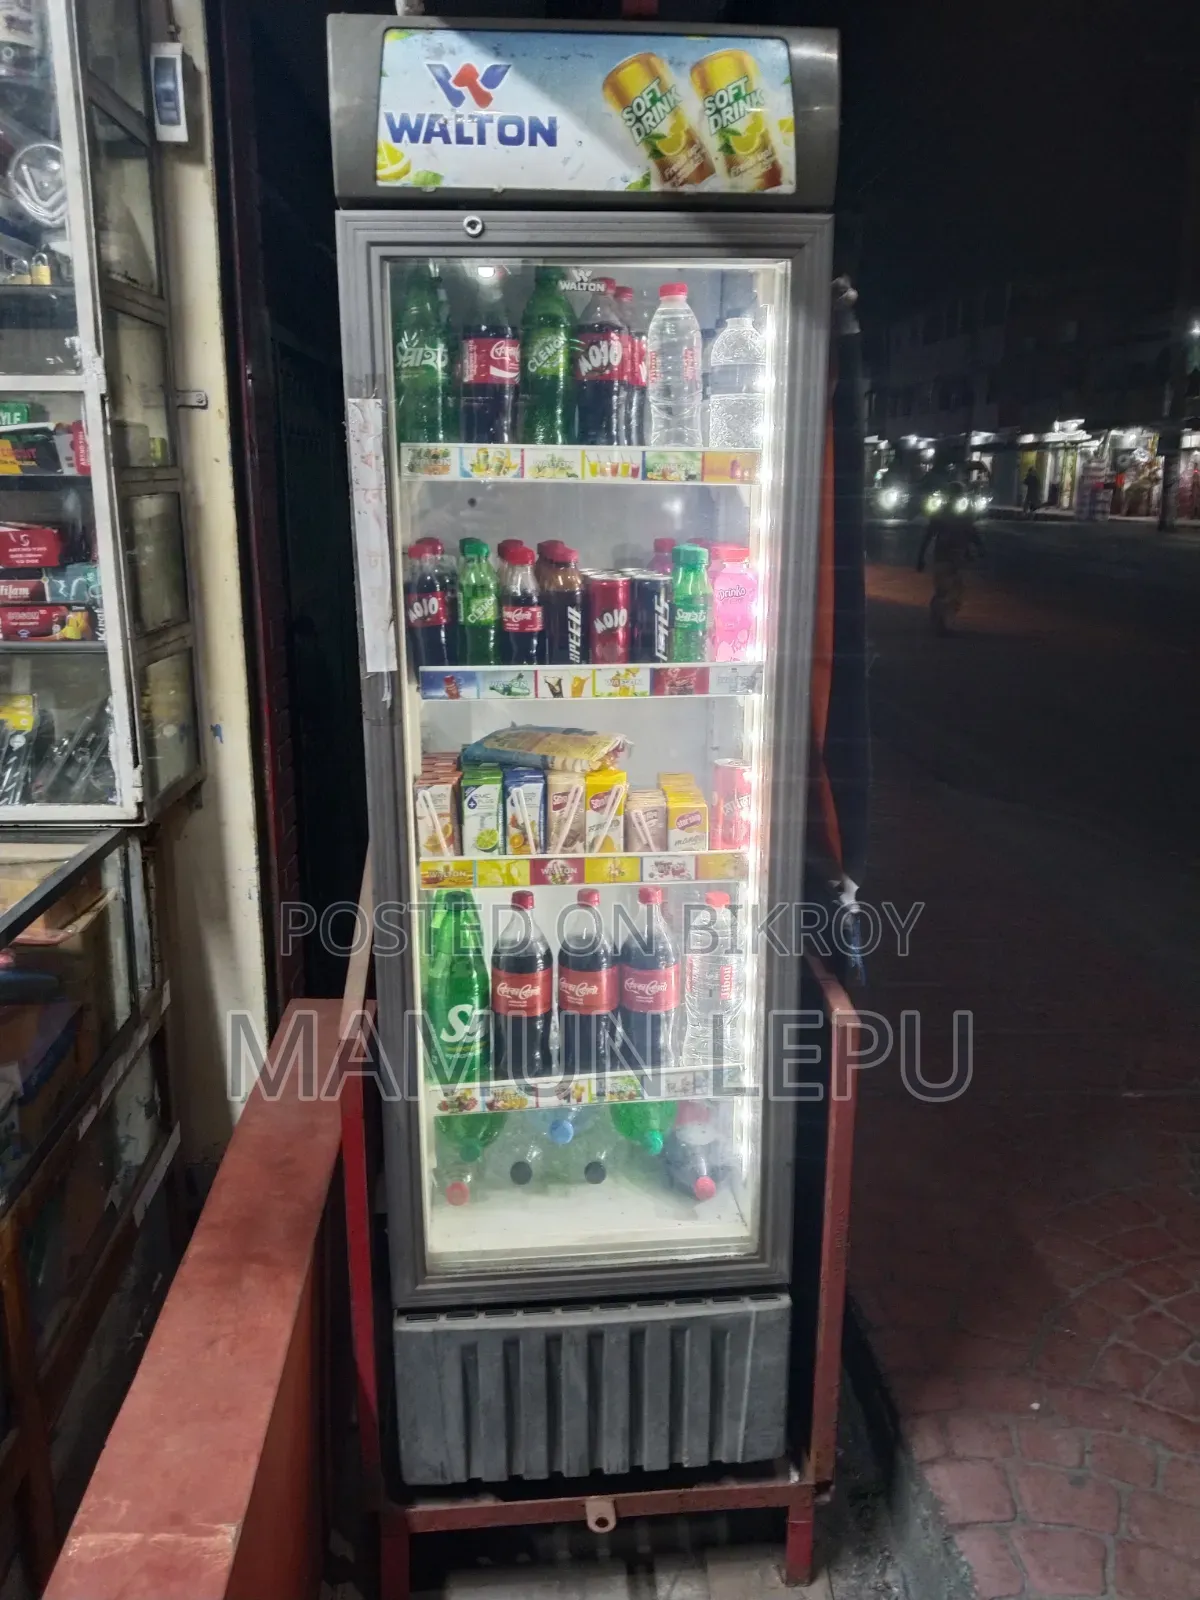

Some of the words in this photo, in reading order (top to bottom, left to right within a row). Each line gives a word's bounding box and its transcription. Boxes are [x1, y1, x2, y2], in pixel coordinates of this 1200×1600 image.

[620, 77, 662, 128] SOFT
[629, 84, 682, 146] DRINK
[703, 75, 749, 117] SOFT
[707, 87, 765, 136] DRINK
[384, 111, 559, 148] WALTON
[559, 280, 606, 292] WALTON
[578, 337, 623, 377] MOJO
[593, 608, 628, 635] MOJO
